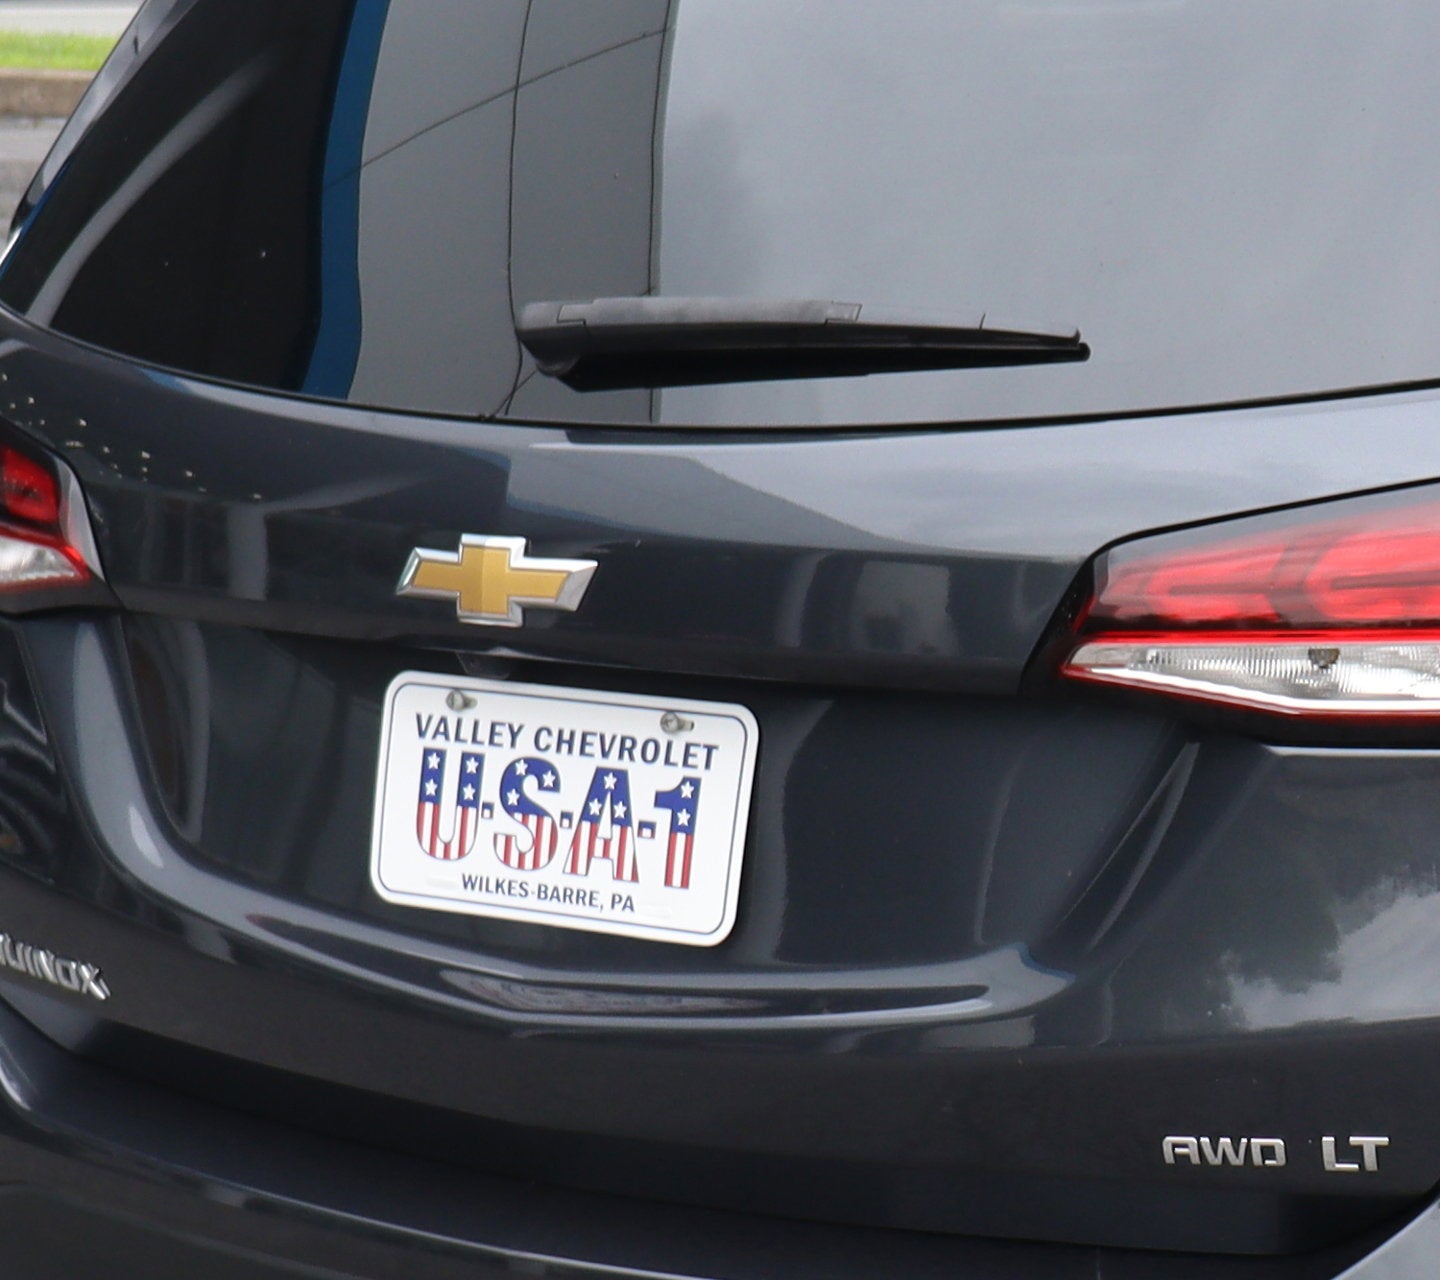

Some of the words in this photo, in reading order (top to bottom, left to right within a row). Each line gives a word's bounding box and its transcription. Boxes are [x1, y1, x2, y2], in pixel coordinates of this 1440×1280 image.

[415, 713, 525, 750] VALLEY
[534, 726, 719, 771] CHEVROLET
[461, 872, 605, 913] WILKES-BARRE,
[610, 893, 636, 913] PA
[1162, 1135, 1288, 1168] AWD
[1321, 1135, 1390, 1173] LT
